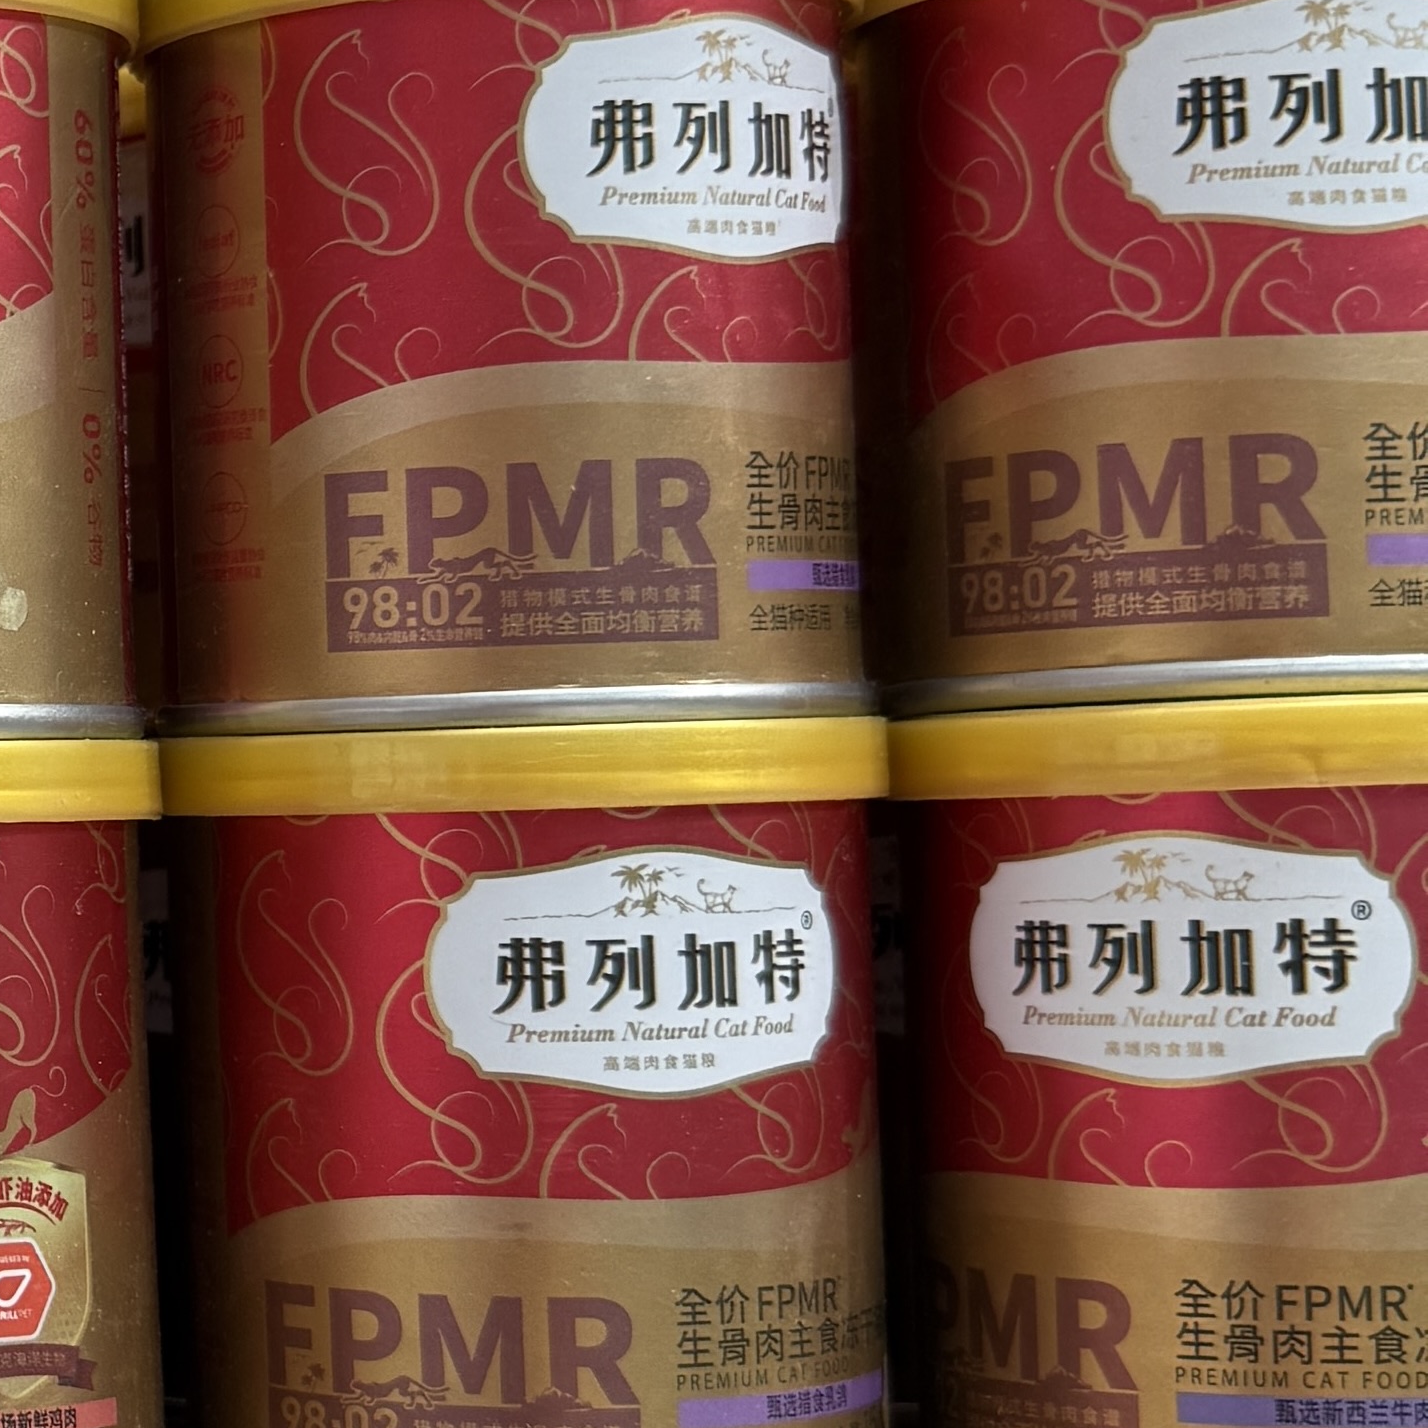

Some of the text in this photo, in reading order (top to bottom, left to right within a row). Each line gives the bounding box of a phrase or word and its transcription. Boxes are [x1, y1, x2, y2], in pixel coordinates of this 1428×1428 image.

[586, 99, 832, 183] 弗列加特
[323, 458, 718, 580] FPMR
[344, 584, 485, 629] 98:02
[500, 610, 704, 637] 提供全面均衡营养
[492, 927, 805, 1015] 弗列加特
[1012, 917, 1358, 997] 弗列加特
[264, 1280, 640, 1407] FPMR
